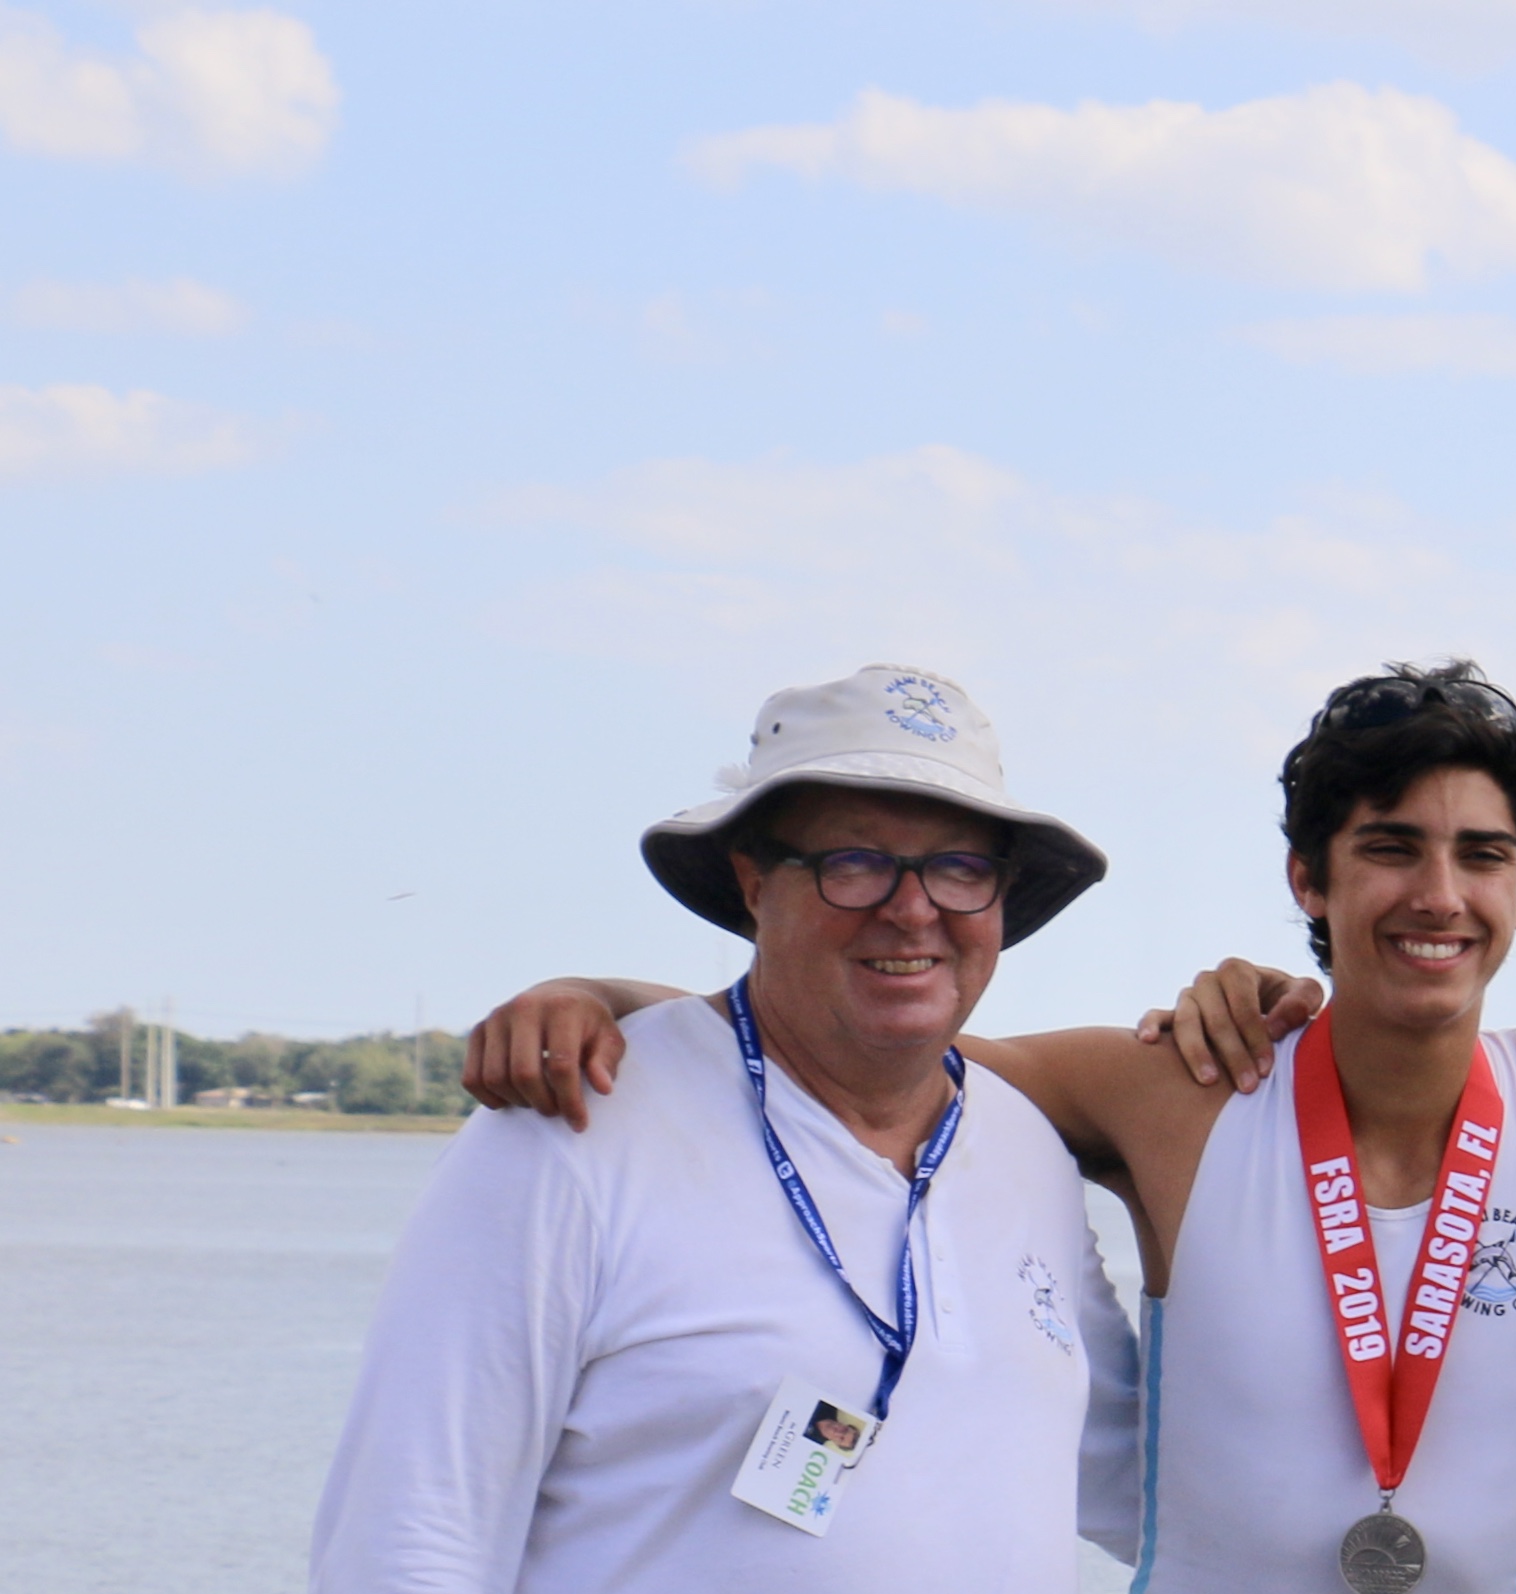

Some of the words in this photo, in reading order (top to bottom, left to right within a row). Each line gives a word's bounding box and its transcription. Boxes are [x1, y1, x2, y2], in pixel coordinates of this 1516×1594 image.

[1310, 1156, 1365, 1255] FSRA
[1405, 1169, 1492, 1360] SARASOTA,
[1456, 1120, 1498, 1161] FL
[1332, 1267, 1386, 1362] 2019
[1461, 1293, 1506, 1316] WING
[787, 1451, 828, 1516] COACH
